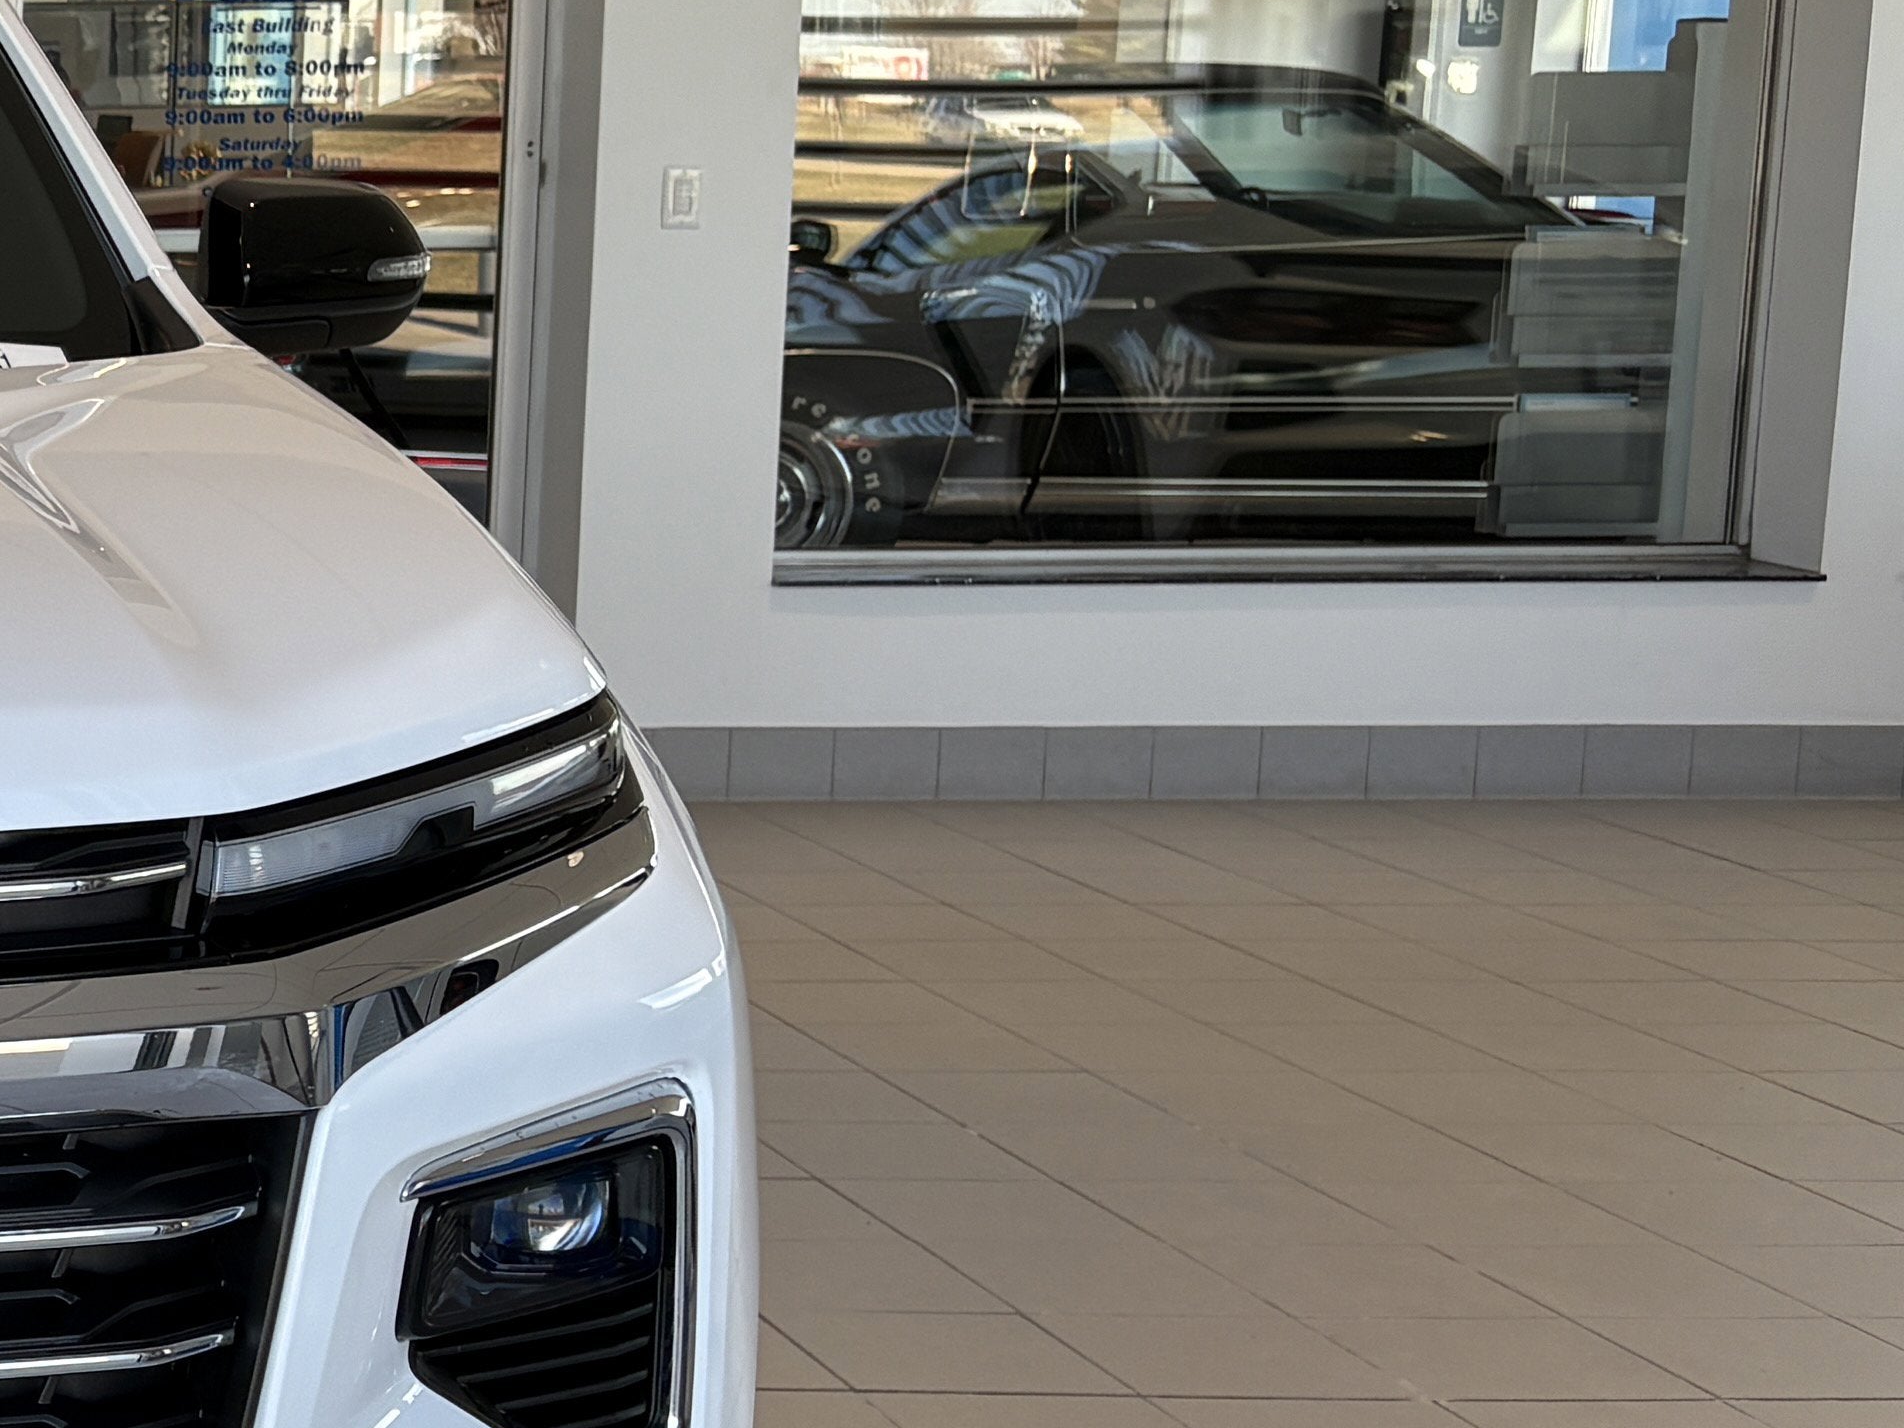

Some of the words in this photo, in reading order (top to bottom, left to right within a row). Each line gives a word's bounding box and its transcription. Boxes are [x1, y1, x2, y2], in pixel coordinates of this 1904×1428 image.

[252, 17, 335, 35] Building
[227, 42, 298, 59] Monday
[256, 59, 277, 77] to
[178, 86, 250, 102] Tuesday
[257, 84, 291, 100] thru
[299, 84, 354, 102] Friday
[165, 109, 245, 125] 9:00am
[253, 109, 275, 125] to
[283, 108, 364, 126] 6:00pm
[220, 137, 303, 154] Saturday
[252, 155, 273, 171] to
